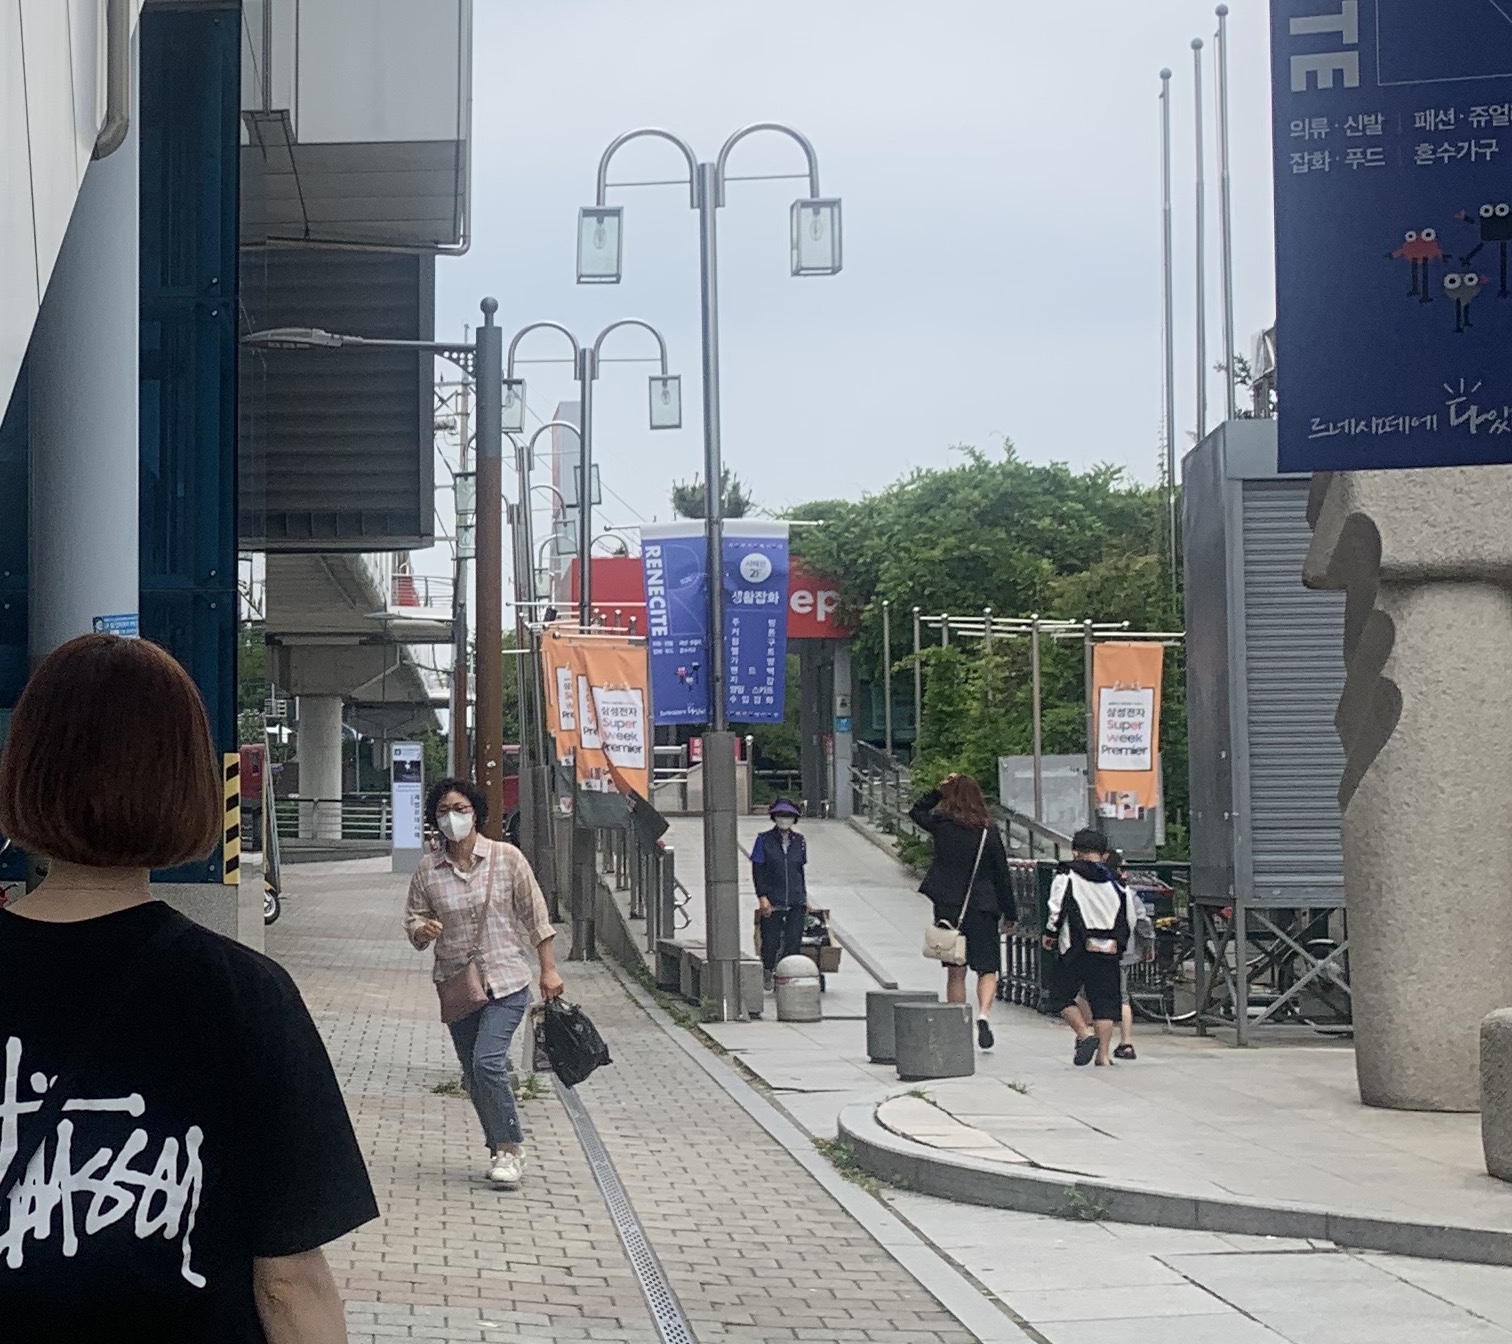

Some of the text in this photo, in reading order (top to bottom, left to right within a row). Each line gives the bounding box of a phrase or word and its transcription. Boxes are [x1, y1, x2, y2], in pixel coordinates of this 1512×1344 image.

[1414, 138, 1499, 165] 혼수가구
[644, 545, 668, 637] RENECITE
[732, 590, 780, 605] 생활잡화
[601, 706, 638, 717] 삼성전자
[1106, 707, 1146, 718] 삼성전자
[602, 717, 636, 730] Super
[1106, 719, 1144, 733] Super
[1101, 744, 1148, 756] Premier
